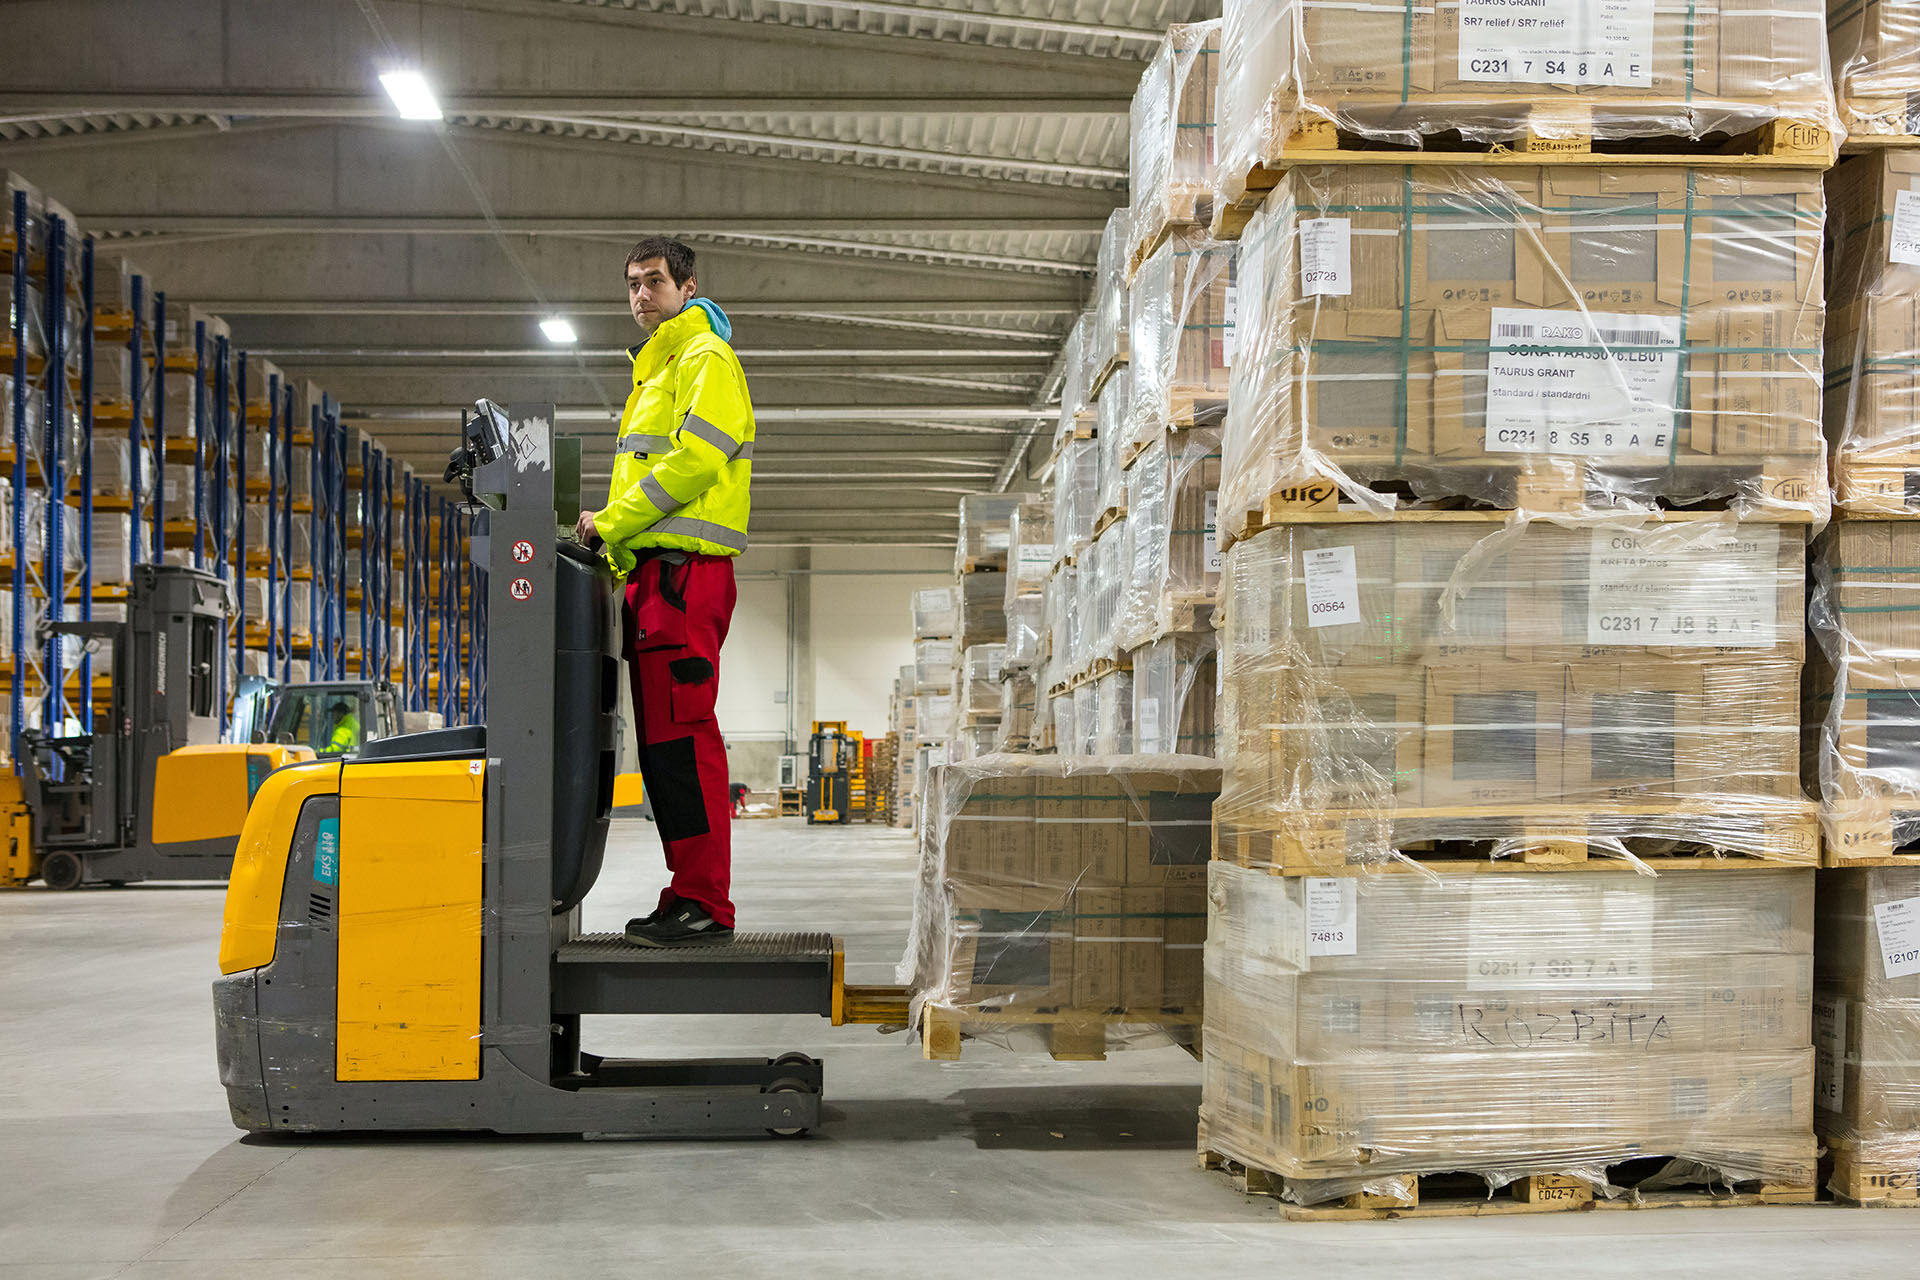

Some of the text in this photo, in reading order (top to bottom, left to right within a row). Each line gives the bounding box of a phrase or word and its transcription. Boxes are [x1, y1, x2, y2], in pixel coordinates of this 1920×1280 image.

[1464, 17, 1483, 27] SR7
[1486, 18, 1510, 27] relief
[1518, 19, 1537, 28] SR7
[1540, 19, 1565, 28] reliéf
[1470, 59, 1640, 77] C231 7 S4 8 A E
[1793, 128, 1820, 146] EUR
[1306, 271, 1337, 282] 02728
[1541, 326, 1583, 340] RAKO
[1494, 366, 1575, 378] TAURUS GRANIT
[1493, 388, 1534, 397] standard
[1498, 430, 1666, 447] C231 8 S5 8 A E
[1312, 601, 1345, 613] 00564
[1600, 616, 1642, 632] C231
[1650, 616, 1659, 631] 7
[322, 855, 332, 877] EKS
[1311, 931, 1344, 942] 74813
[1889, 950, 1920, 965] 12107
[1478, 961, 1519, 976] C231
[1606, 961, 1618, 975] A
[1628, 961, 1639, 975] E
[1829, 1084, 1836, 1098] E
[1539, 1189, 1576, 1200] CD42-7
